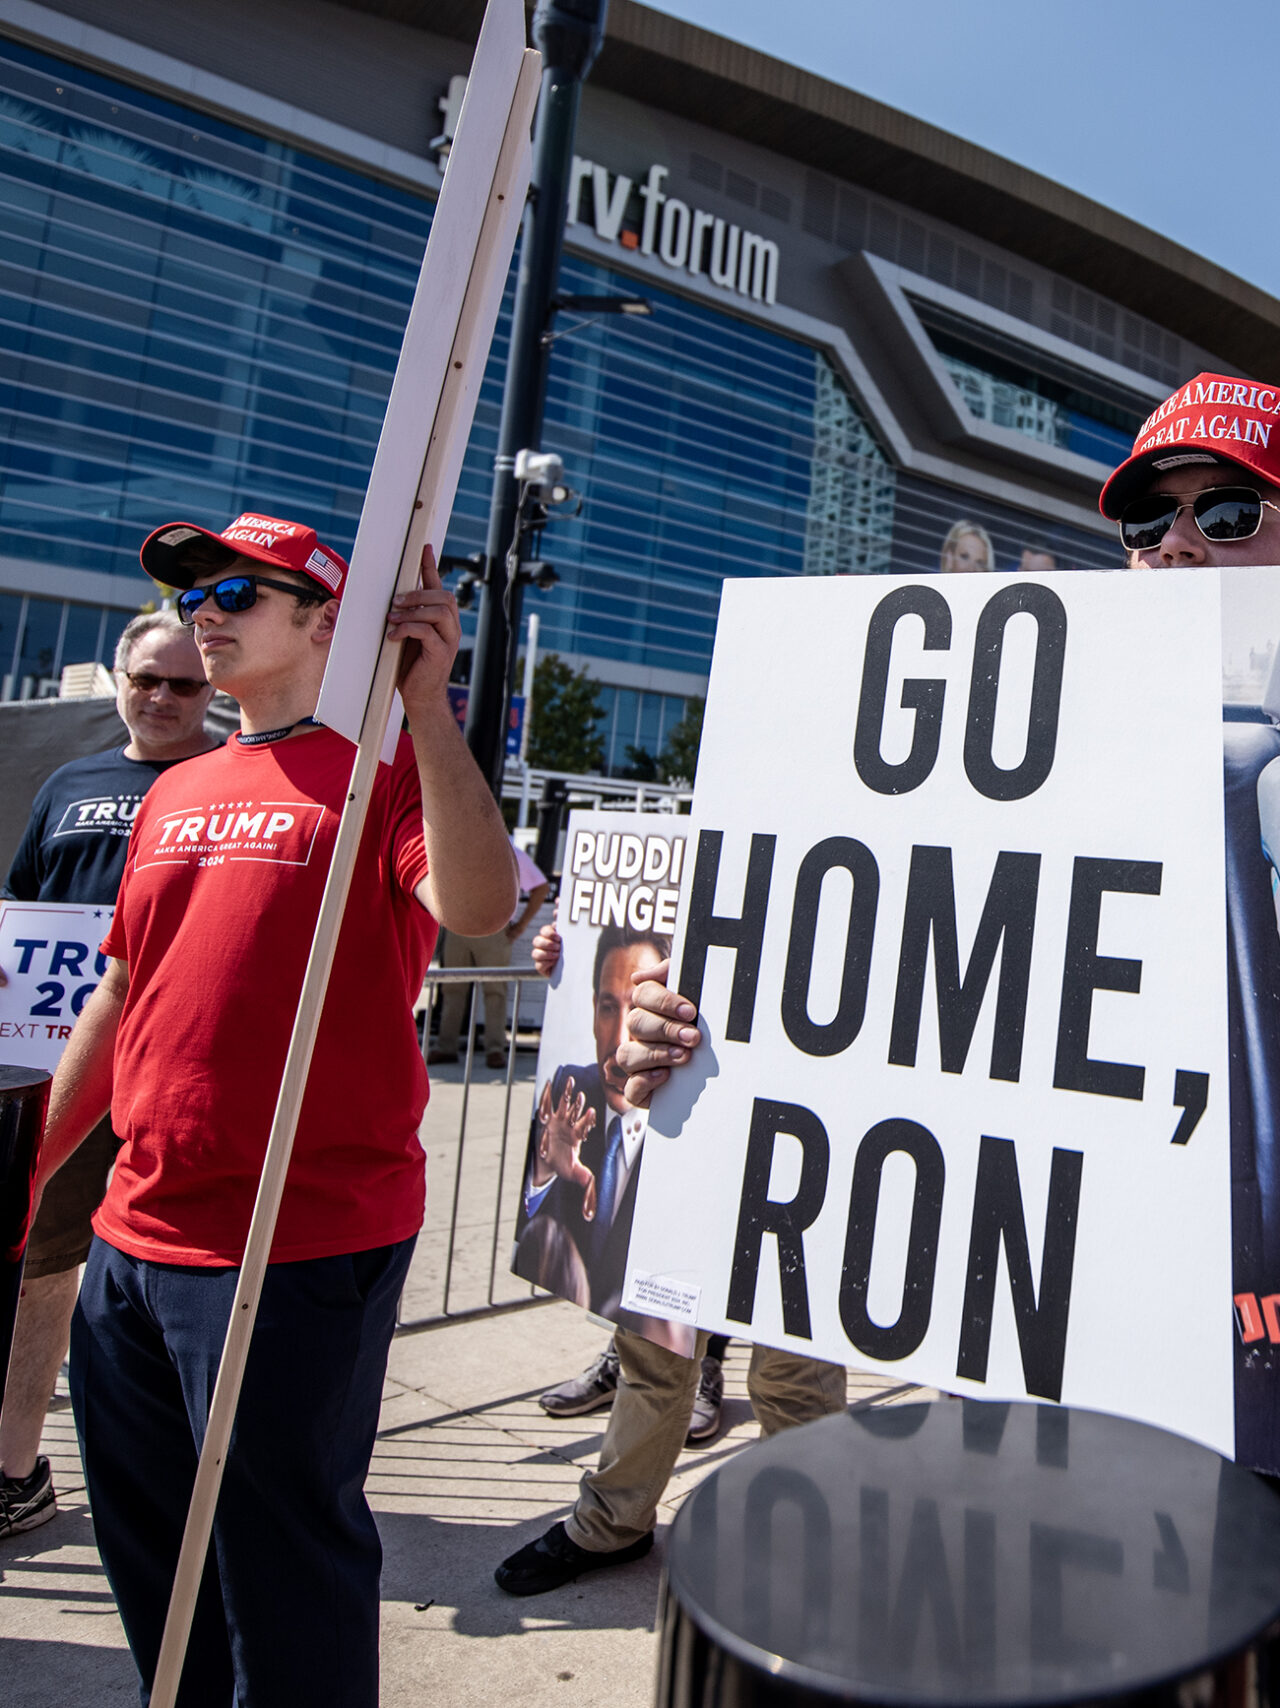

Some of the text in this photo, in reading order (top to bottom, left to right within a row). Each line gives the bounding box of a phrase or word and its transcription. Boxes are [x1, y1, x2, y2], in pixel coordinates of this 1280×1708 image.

[1191, 415, 1273, 448] AGAIN
[853, 582, 1067, 802] GO
[78, 802, 142, 821] TRU
[109, 827, 132, 837] 202
[159, 812, 295, 845] TRUMP
[154, 846, 176, 855] MAKE
[219, 842, 242, 851] GREAT
[243, 841, 277, 851] AGAIN!
[198, 855, 225, 867] 2024
[571, 830, 687, 884] PUDDI
[570, 879, 680, 935] FINGE
[678, 829, 1210, 1146] HOME,
[0, 1022, 39, 1038] EXT
[726, 1096, 1084, 1403] RON
